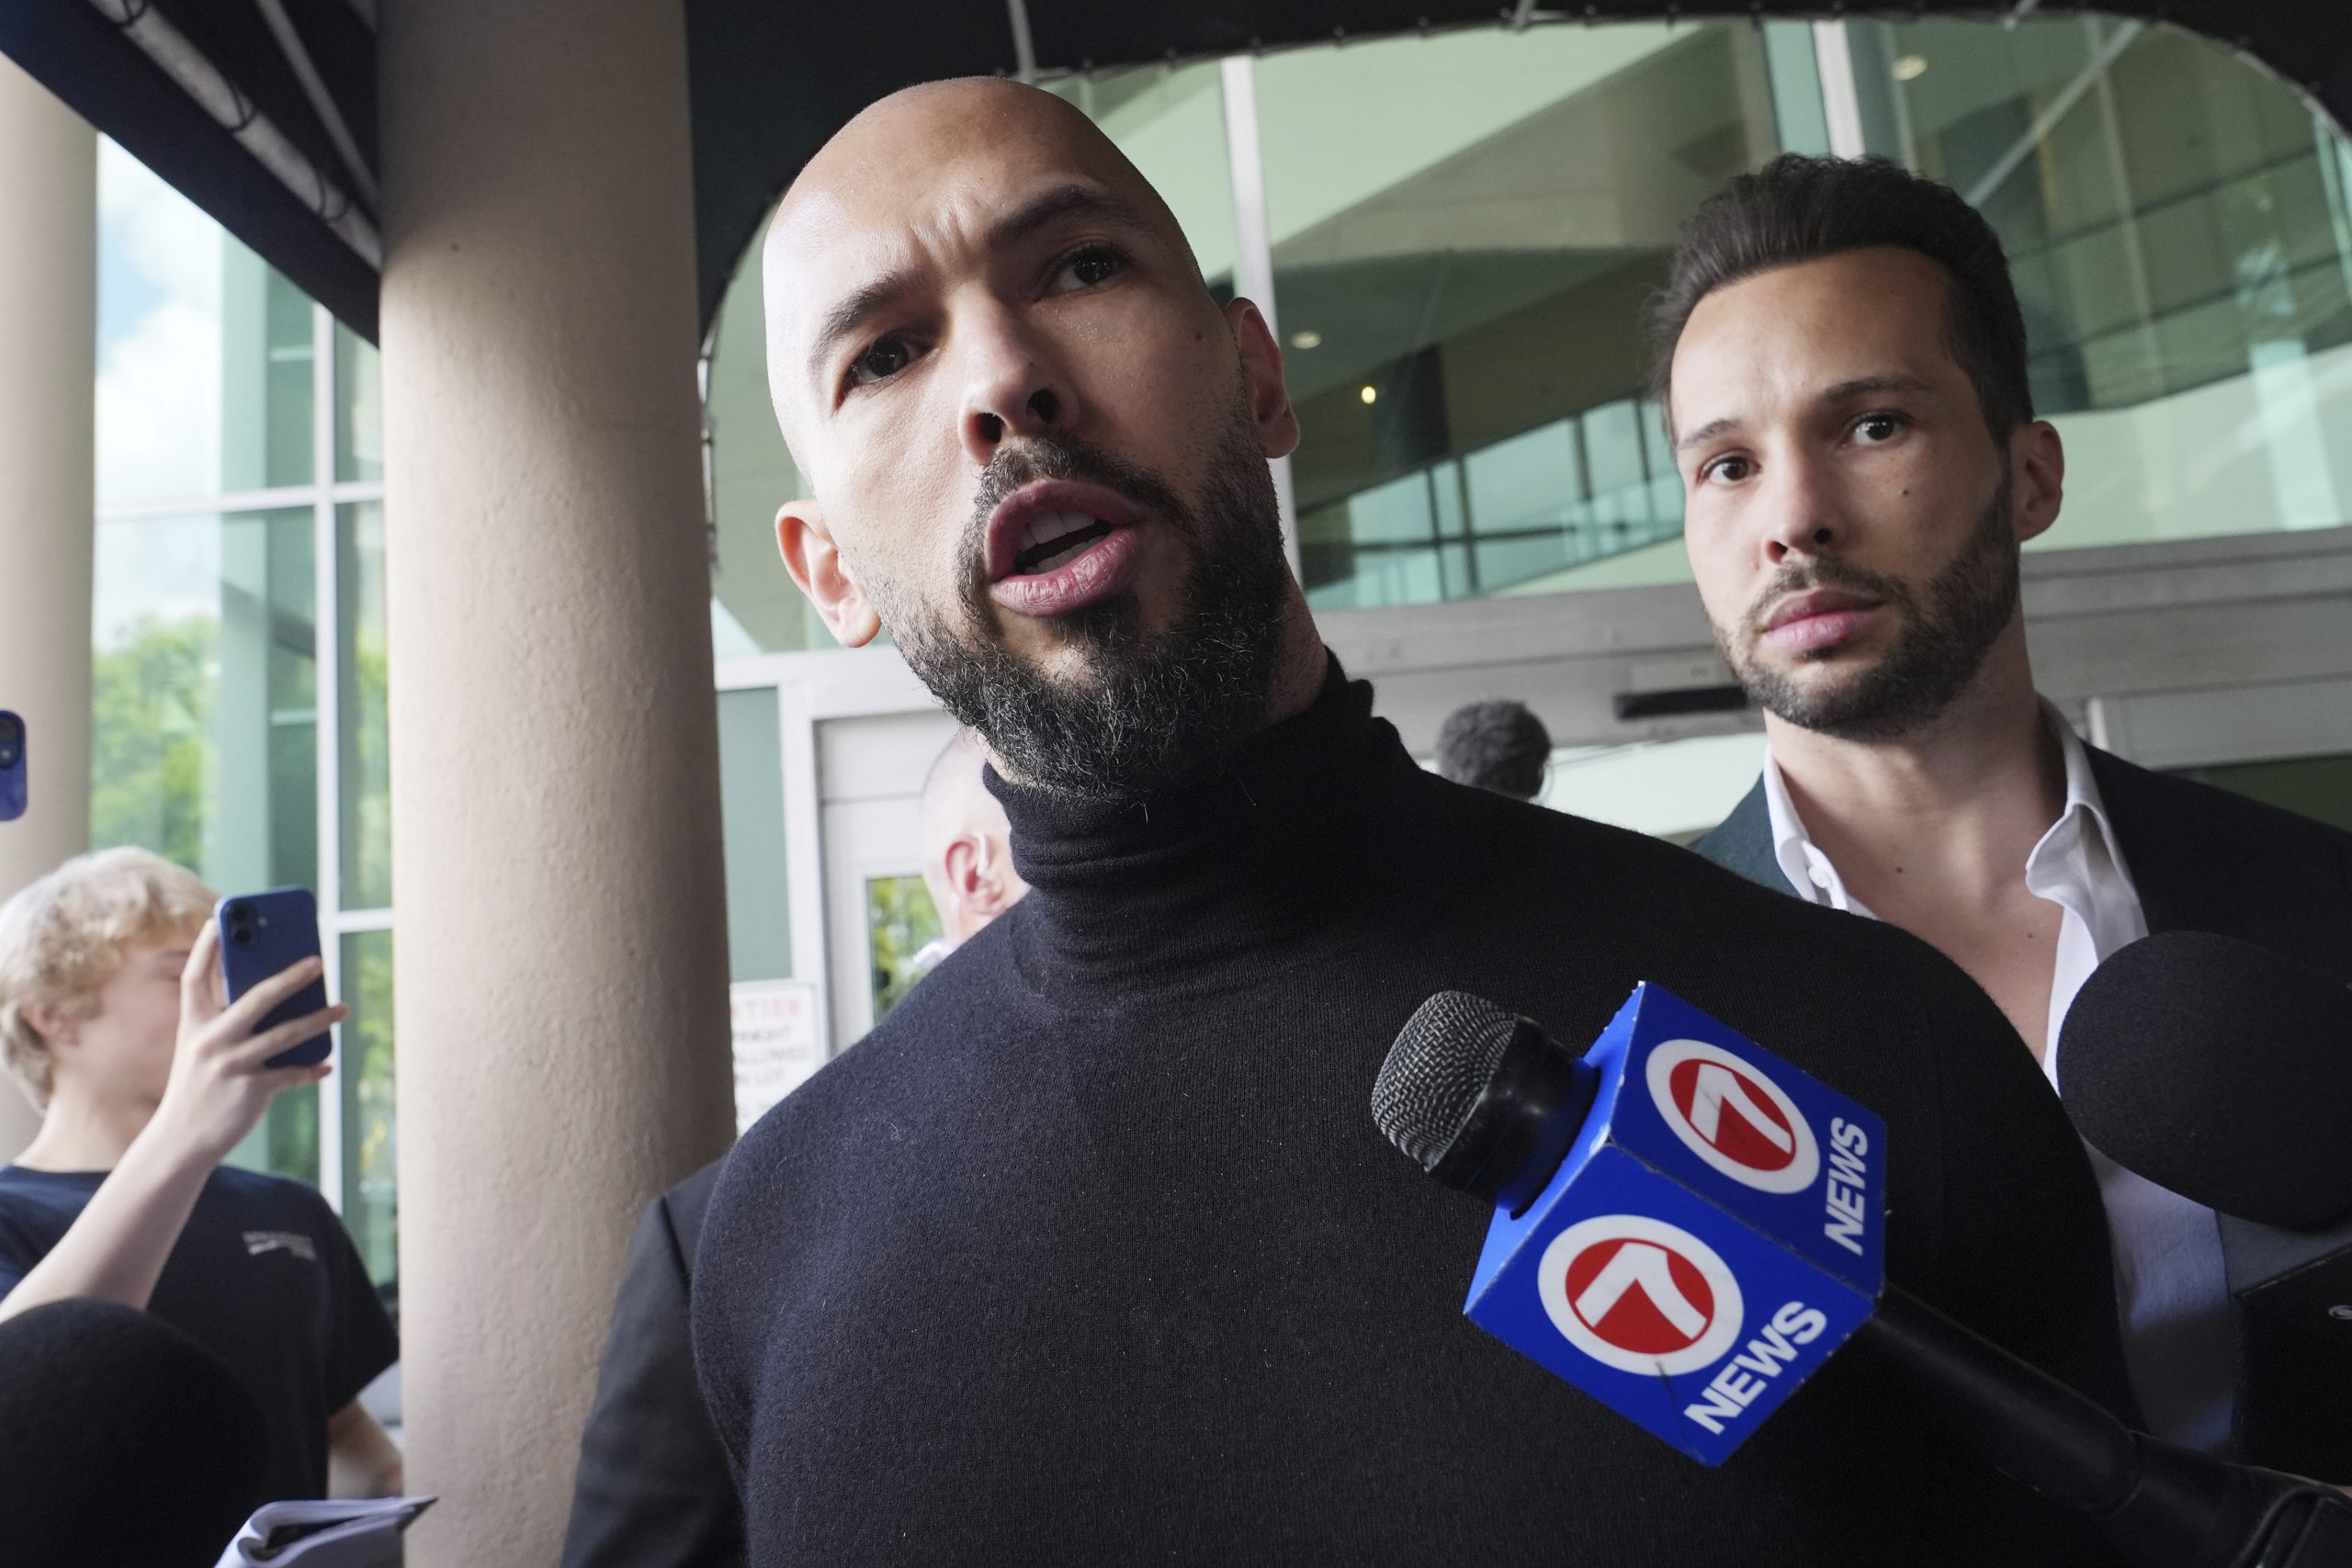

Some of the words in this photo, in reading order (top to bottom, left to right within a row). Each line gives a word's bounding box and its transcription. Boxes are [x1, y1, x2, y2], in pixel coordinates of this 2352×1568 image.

[1690, 1064, 1792, 1154] 7
[1825, 1118, 1868, 1256] NEWS
[1575, 1243, 1707, 1338] 7
[1683, 1302, 1826, 1434] NEWS
